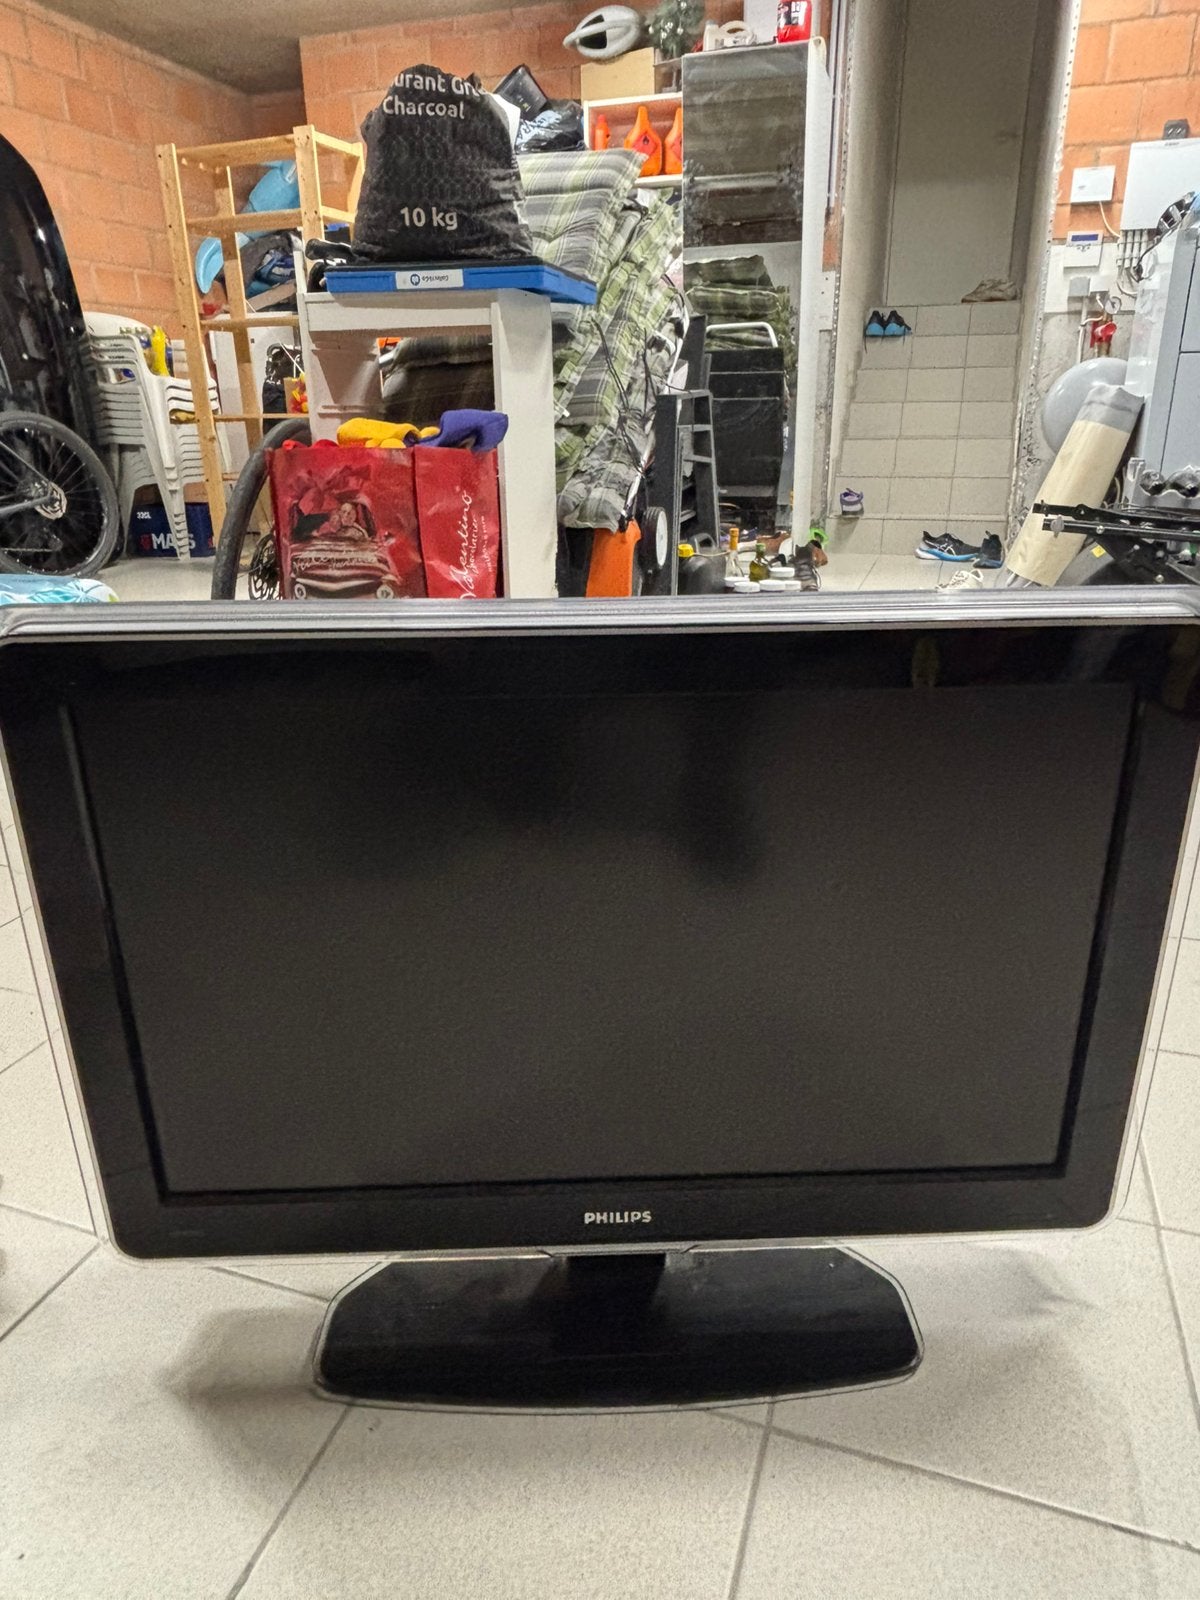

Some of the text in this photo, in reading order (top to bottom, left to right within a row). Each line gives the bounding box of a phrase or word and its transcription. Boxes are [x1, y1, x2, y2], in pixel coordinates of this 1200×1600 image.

[389, 73, 446, 93] urant
[382, 95, 465, 120] Charcoal
[400, 206, 459, 231] 10 kg
[151, 532, 197, 550] MAS
[583, 1209, 653, 1225] PHILIPS
